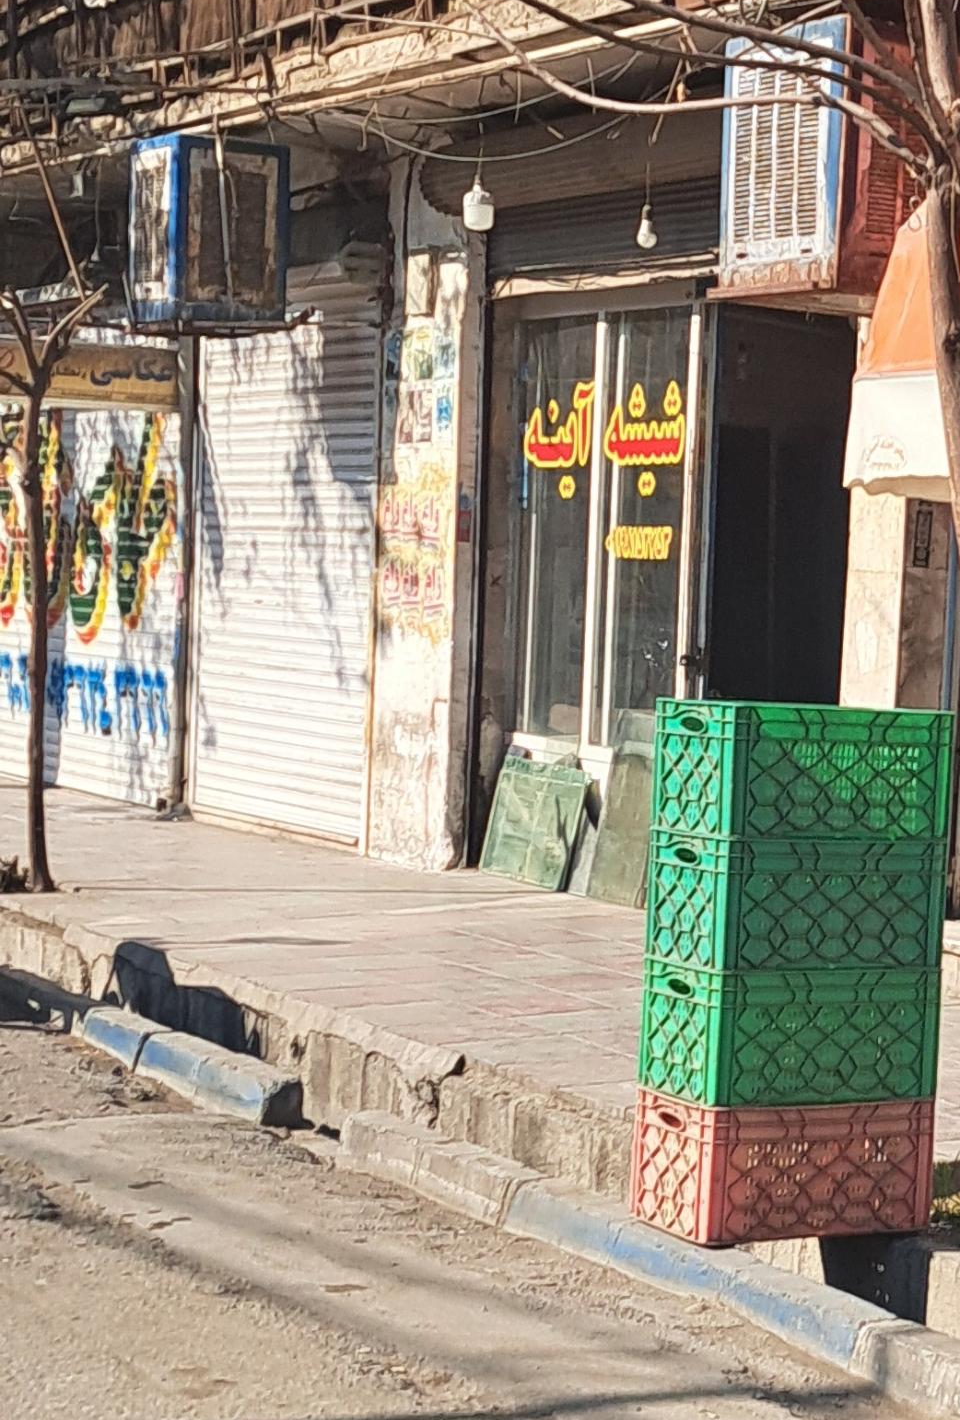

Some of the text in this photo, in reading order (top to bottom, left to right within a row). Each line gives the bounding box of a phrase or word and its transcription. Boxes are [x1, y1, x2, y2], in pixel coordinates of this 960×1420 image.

[90, 357, 174, 387] عکاسی
[524, 381, 595, 500] آینه
[604, 380, 685, 498] شیشه
